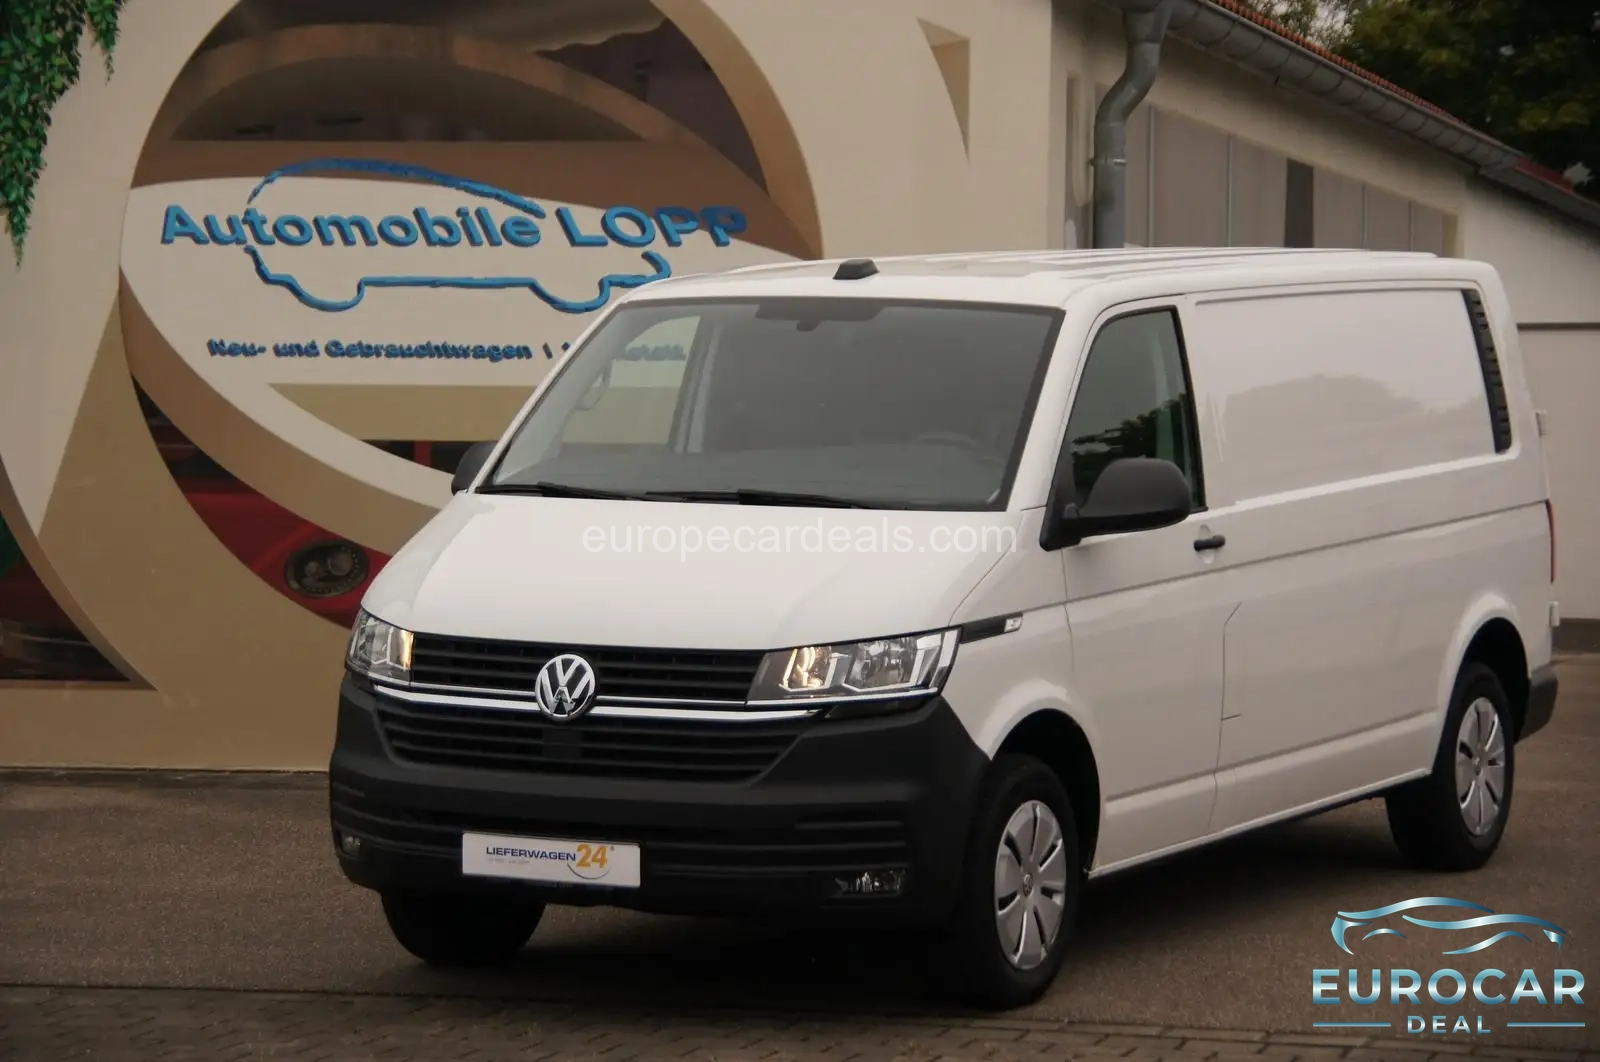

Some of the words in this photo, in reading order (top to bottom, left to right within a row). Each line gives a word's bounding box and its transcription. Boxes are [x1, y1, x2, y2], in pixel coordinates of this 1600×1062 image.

[160, 204, 541, 247] Automobile
[555, 206, 746, 247] LOPP
[272, 339, 320, 358] und
[325, 339, 533, 363] Gebrauchtwagen
